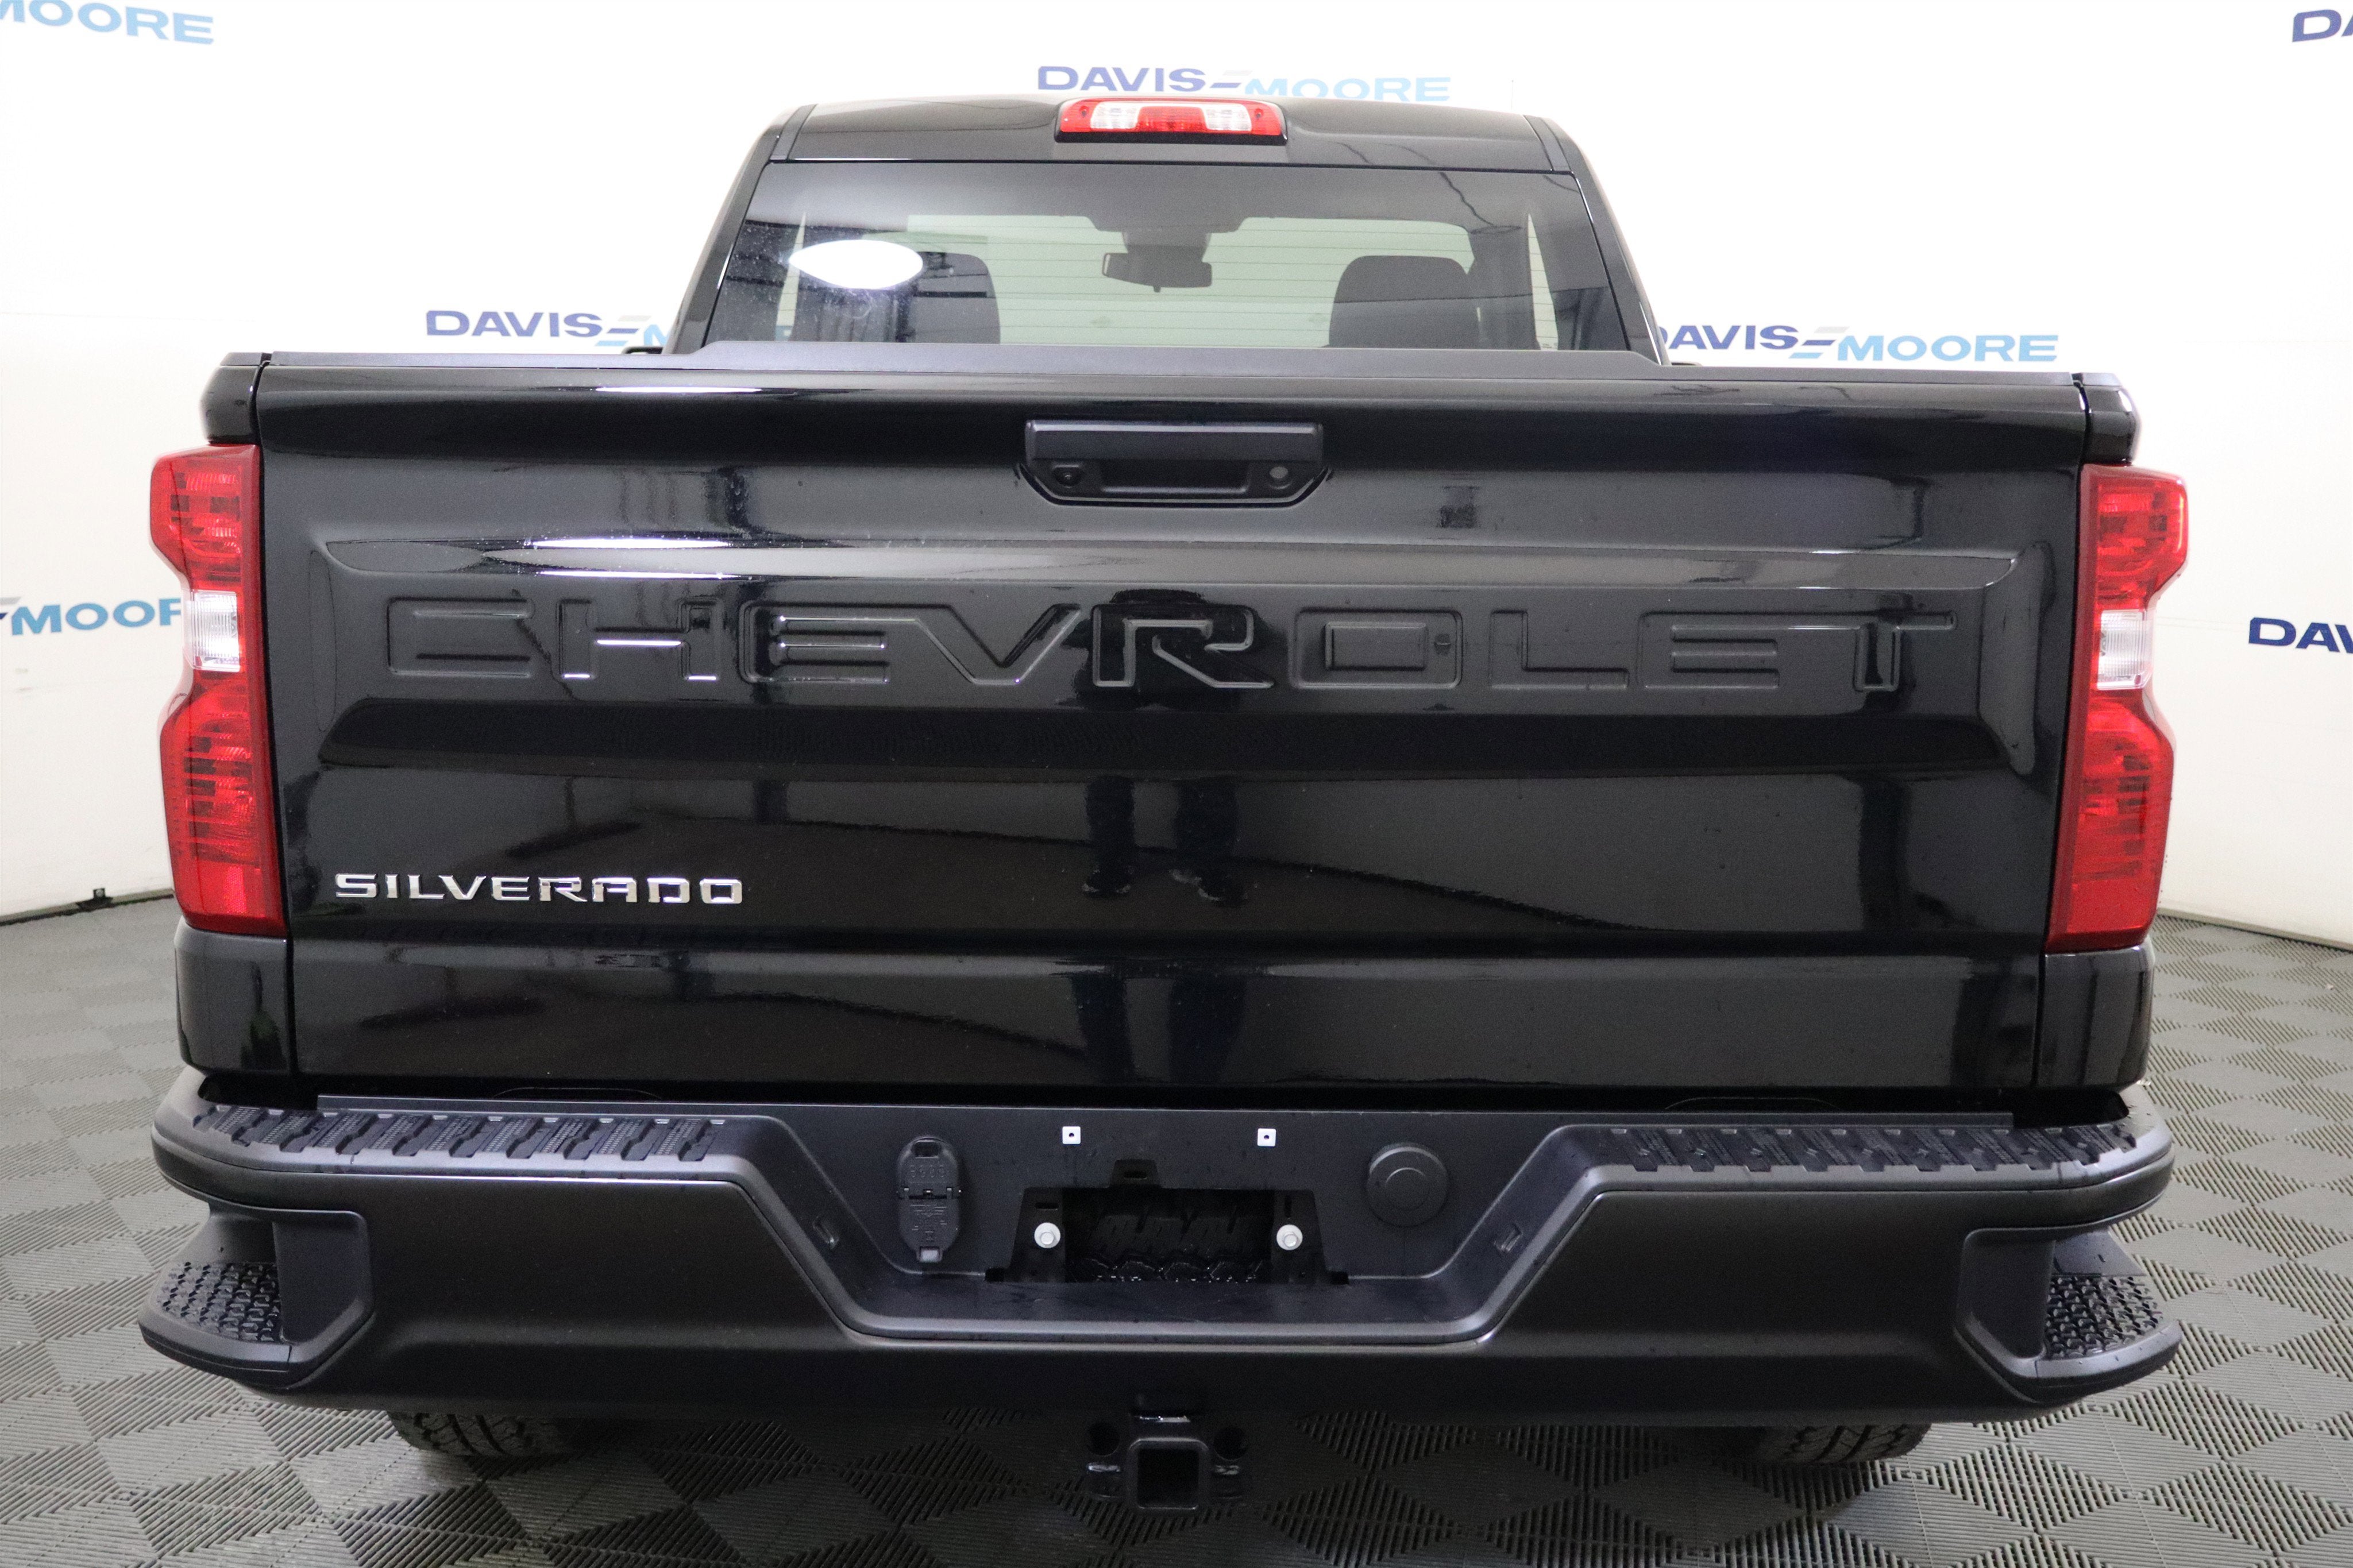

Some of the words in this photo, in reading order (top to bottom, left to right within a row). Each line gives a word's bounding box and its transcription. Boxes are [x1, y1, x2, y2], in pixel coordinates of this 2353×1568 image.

[2292, 9, 2353, 42] D
[1038, 65, 1206, 92] DAVIS
[1245, 77, 1451, 102] MOORE
[426, 310, 603, 338] DAVIS
[1659, 325, 1799, 350] AVIS
[1838, 334, 2059, 362] MOORE
[387, 596, 1955, 691] CHEVROLET
[335, 873, 743, 904] SILVERADO
